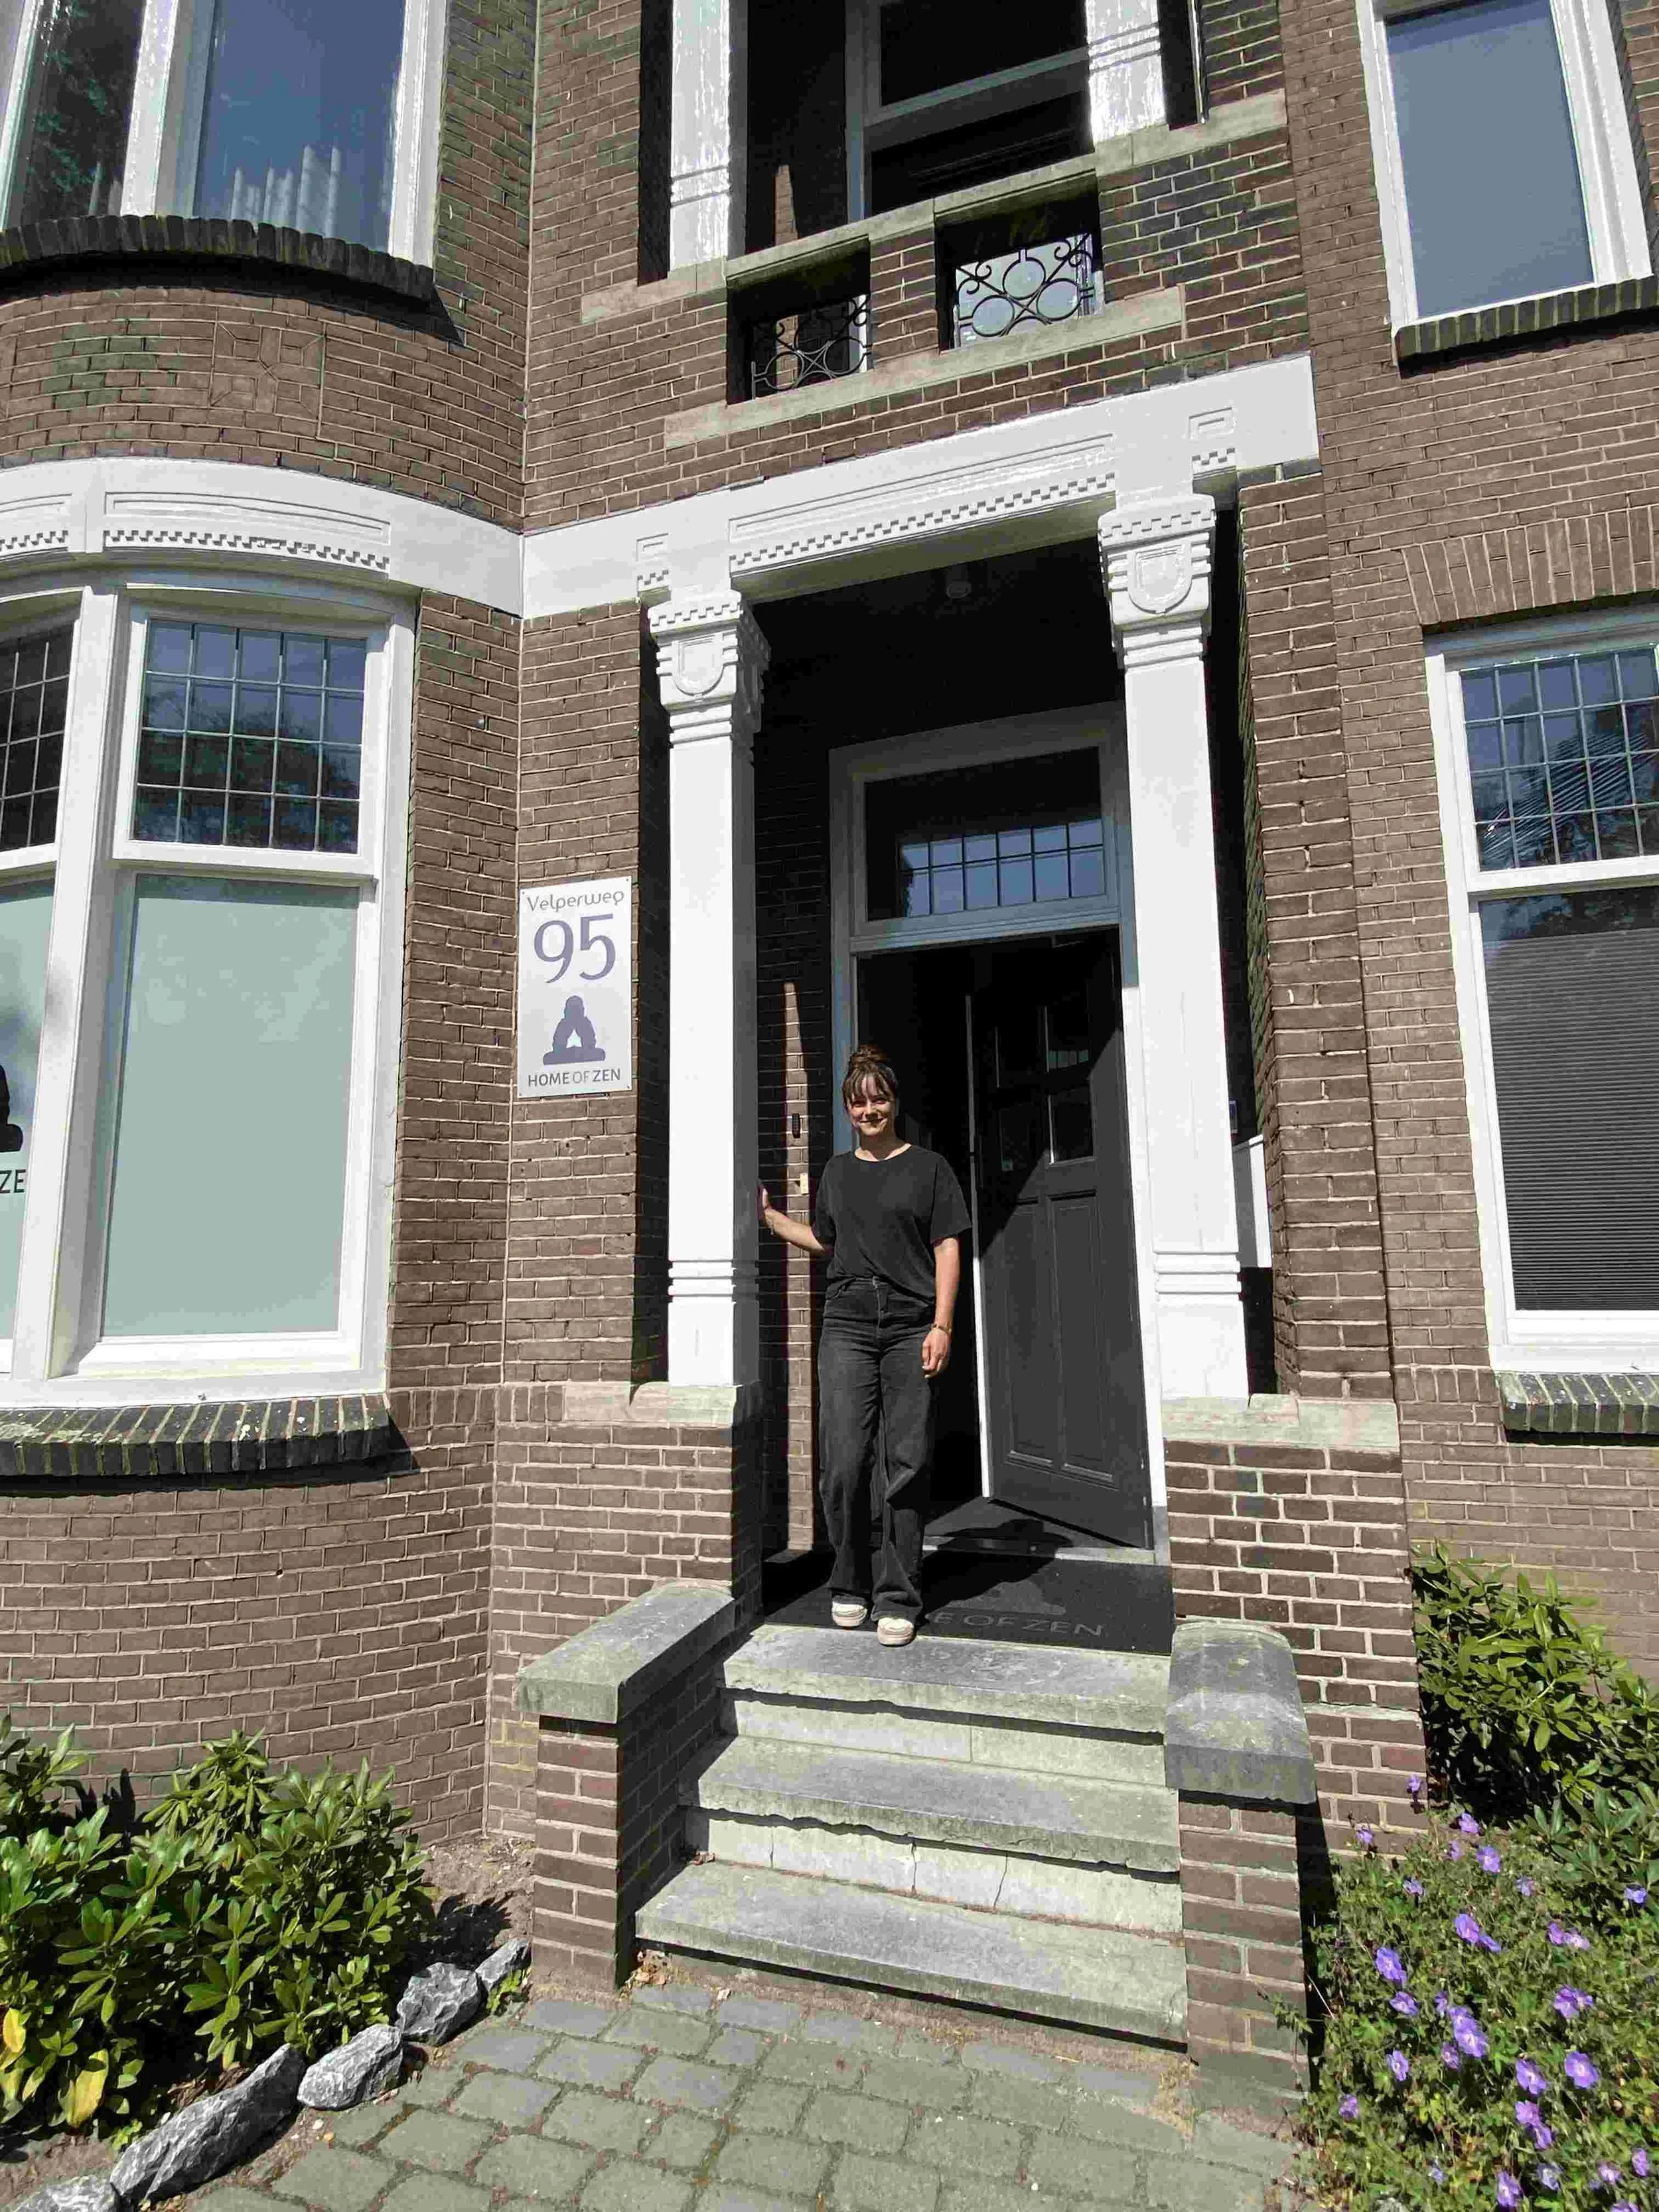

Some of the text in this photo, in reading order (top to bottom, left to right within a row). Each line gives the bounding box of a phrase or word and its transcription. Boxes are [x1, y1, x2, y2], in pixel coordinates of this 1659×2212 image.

[526, 891, 624, 912] Velperweg
[534, 913, 616, 984] 95
[0, 1169, 27, 1194] ZE
[1021, 1619, 1104, 1637] ZEN
